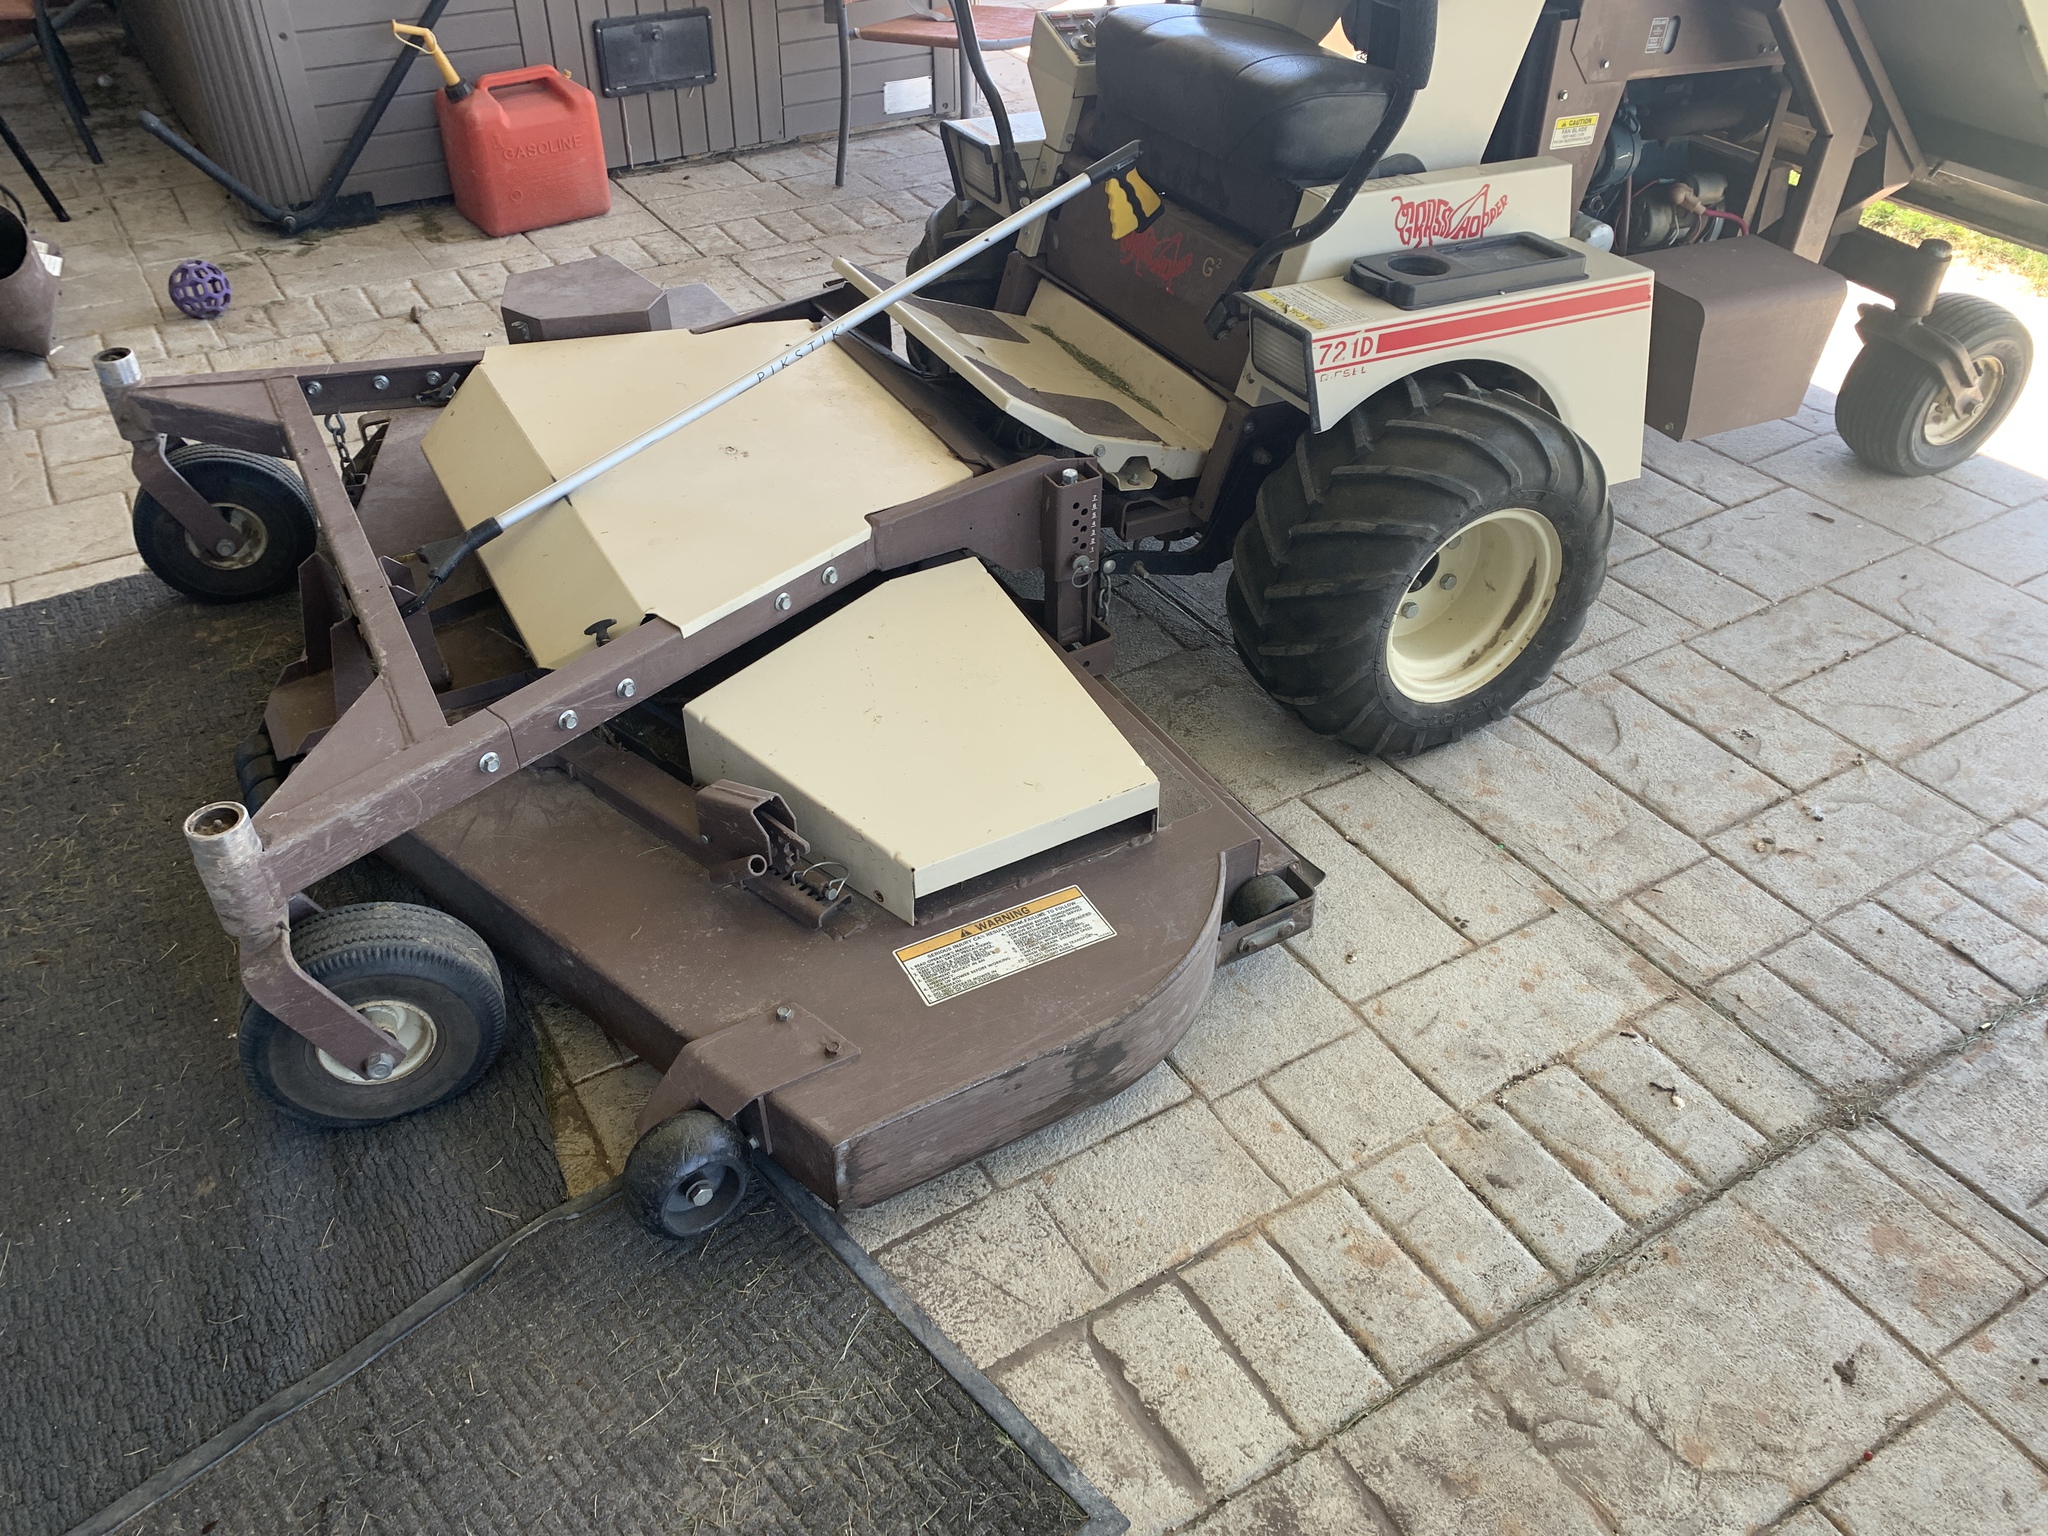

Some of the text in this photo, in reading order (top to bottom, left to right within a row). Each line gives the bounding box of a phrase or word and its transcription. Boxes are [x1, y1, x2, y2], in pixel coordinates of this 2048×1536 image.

[1568, 118, 1592, 126] CAUTION
[503, 134, 584, 160] GASOLINE
[756, 325, 842, 383] PIKSTIK
[1319, 335, 1374, 365] 721D
[1320, 366, 1367, 382] DESEL
[926, 946, 952, 958] SERIOUS
[951, 939, 972, 949] INJURY
[984, 926, 1006, 936] RESULT
[1023, 912, 1045, 922] FAILURE
[1054, 900, 1076, 911] FOLLOW
[974, 906, 1031, 931] WARNING
